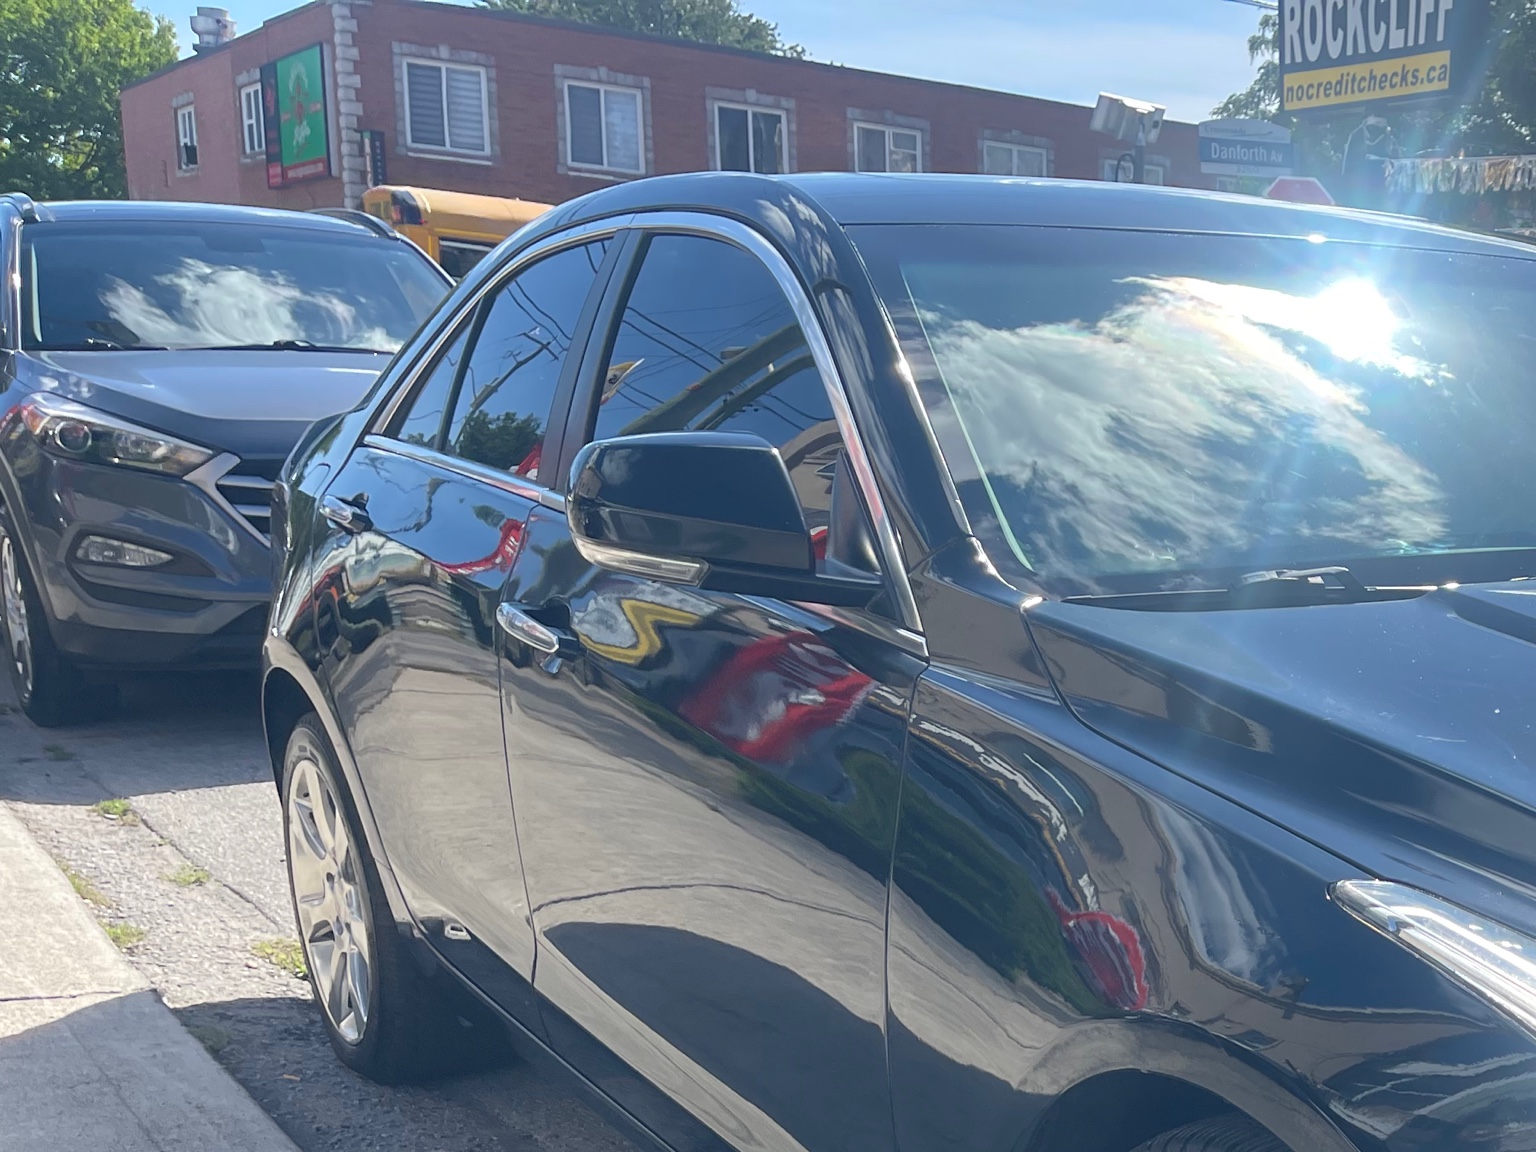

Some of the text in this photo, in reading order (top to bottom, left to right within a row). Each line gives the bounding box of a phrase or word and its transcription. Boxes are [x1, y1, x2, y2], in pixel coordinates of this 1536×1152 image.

[1284, 0, 1453, 64] ROCKCLIFF
[1285, 63, 1448, 103] nocreditchecks.ca
[1210, 142, 1283, 163] Danforth Av
